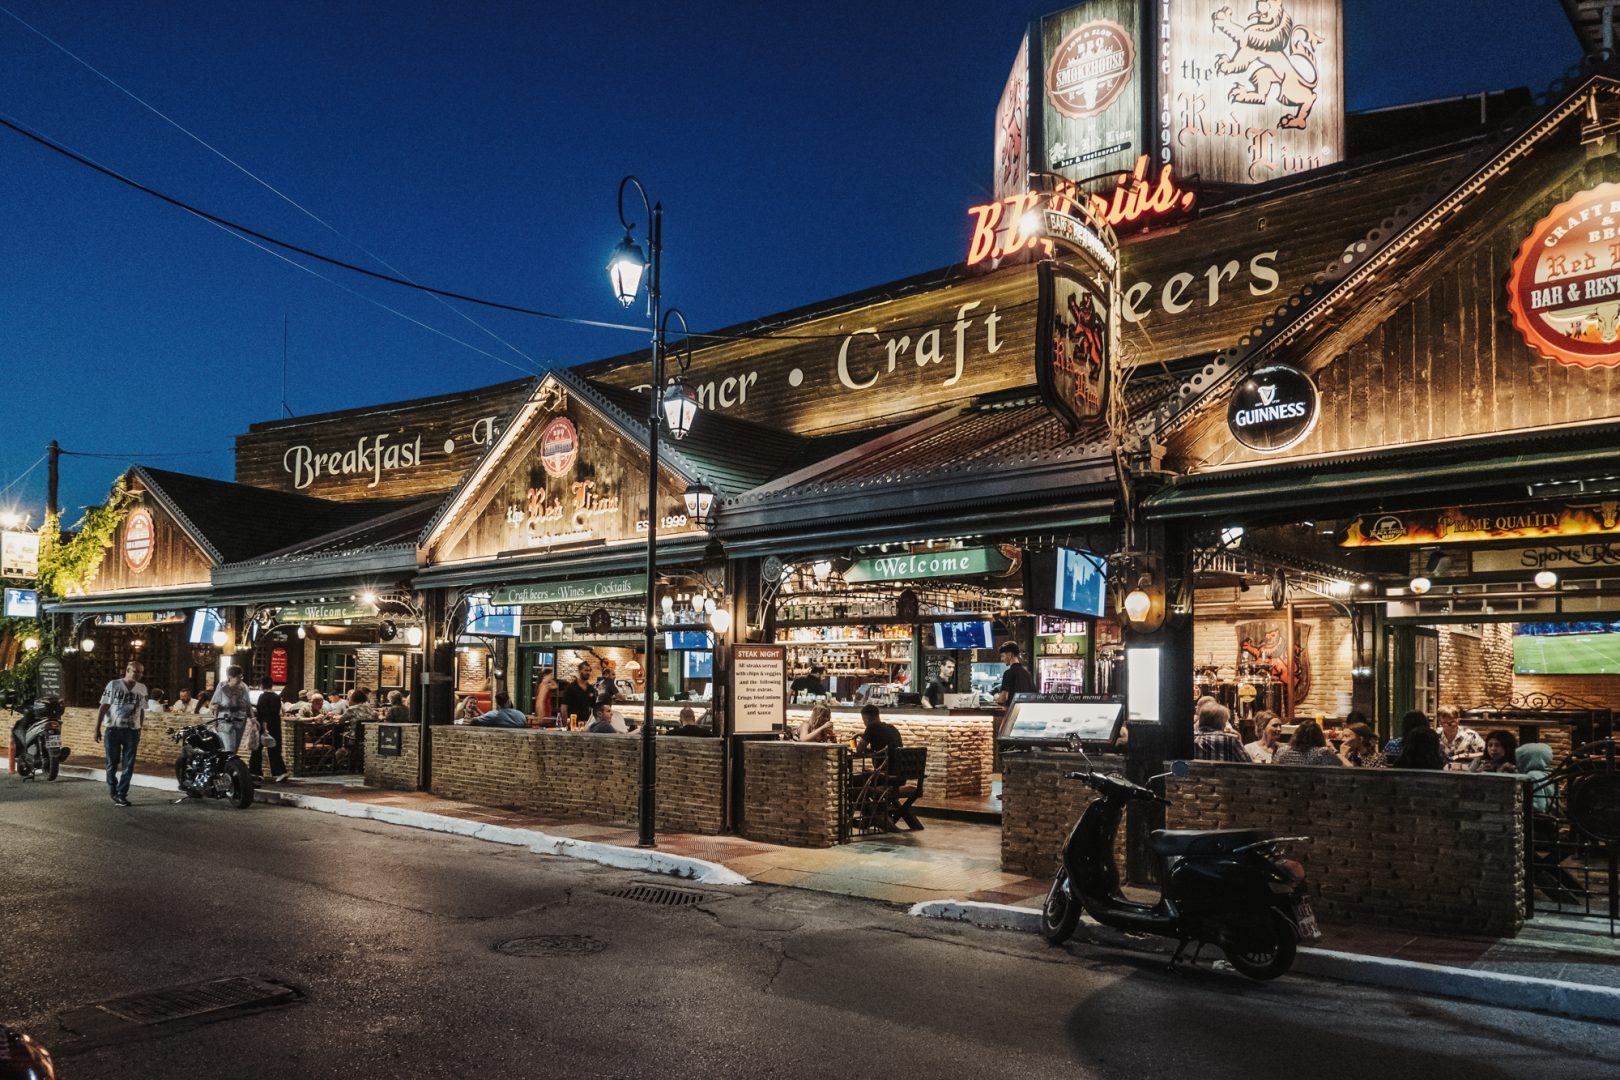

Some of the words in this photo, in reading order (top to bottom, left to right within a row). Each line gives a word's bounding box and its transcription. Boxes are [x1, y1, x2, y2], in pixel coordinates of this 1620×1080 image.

[1077, 37, 1105, 53] BBQ
[1160, 0, 1171, 75] ince
[1055, 50, 1125, 87] SMOKEHOUSE
[1181, 59, 1213, 86] the
[1160, 95, 1172, 164] 1999
[1177, 92, 1242, 148] Red
[1082, 145, 1121, 161] restaurant
[1244, 128, 1322, 181] Lion
[1543, 204, 1604, 249] CRAFT
[1588, 226, 1620, 243] BB
[1545, 252, 1597, 282] Red
[1121, 248, 1281, 324] eers
[1531, 284, 1564, 309] BAR
[1566, 282, 1582, 301] &
[837, 300, 1004, 390] Craft
[1235, 401, 1306, 426] GUINNESS
[283, 433, 422, 489] Breakfast
[527, 487, 563, 534] Red
[571, 480, 619, 529] Lion
[636, 520, 649, 533] ES
[661, 515, 688, 529] 1999
[1495, 512, 1561, 531] QUALITY
[874, 553, 971, 579] Welcome
[508, 589, 529, 603] Craft
[529, 588, 549, 600] beers
[557, 585, 586, 599] Wines
[594, 579, 632, 597] Cocktails
[304, 605, 347, 619] Welcome
[738, 650, 758, 658] STEAK
[759, 650, 780, 658] NIGHT
